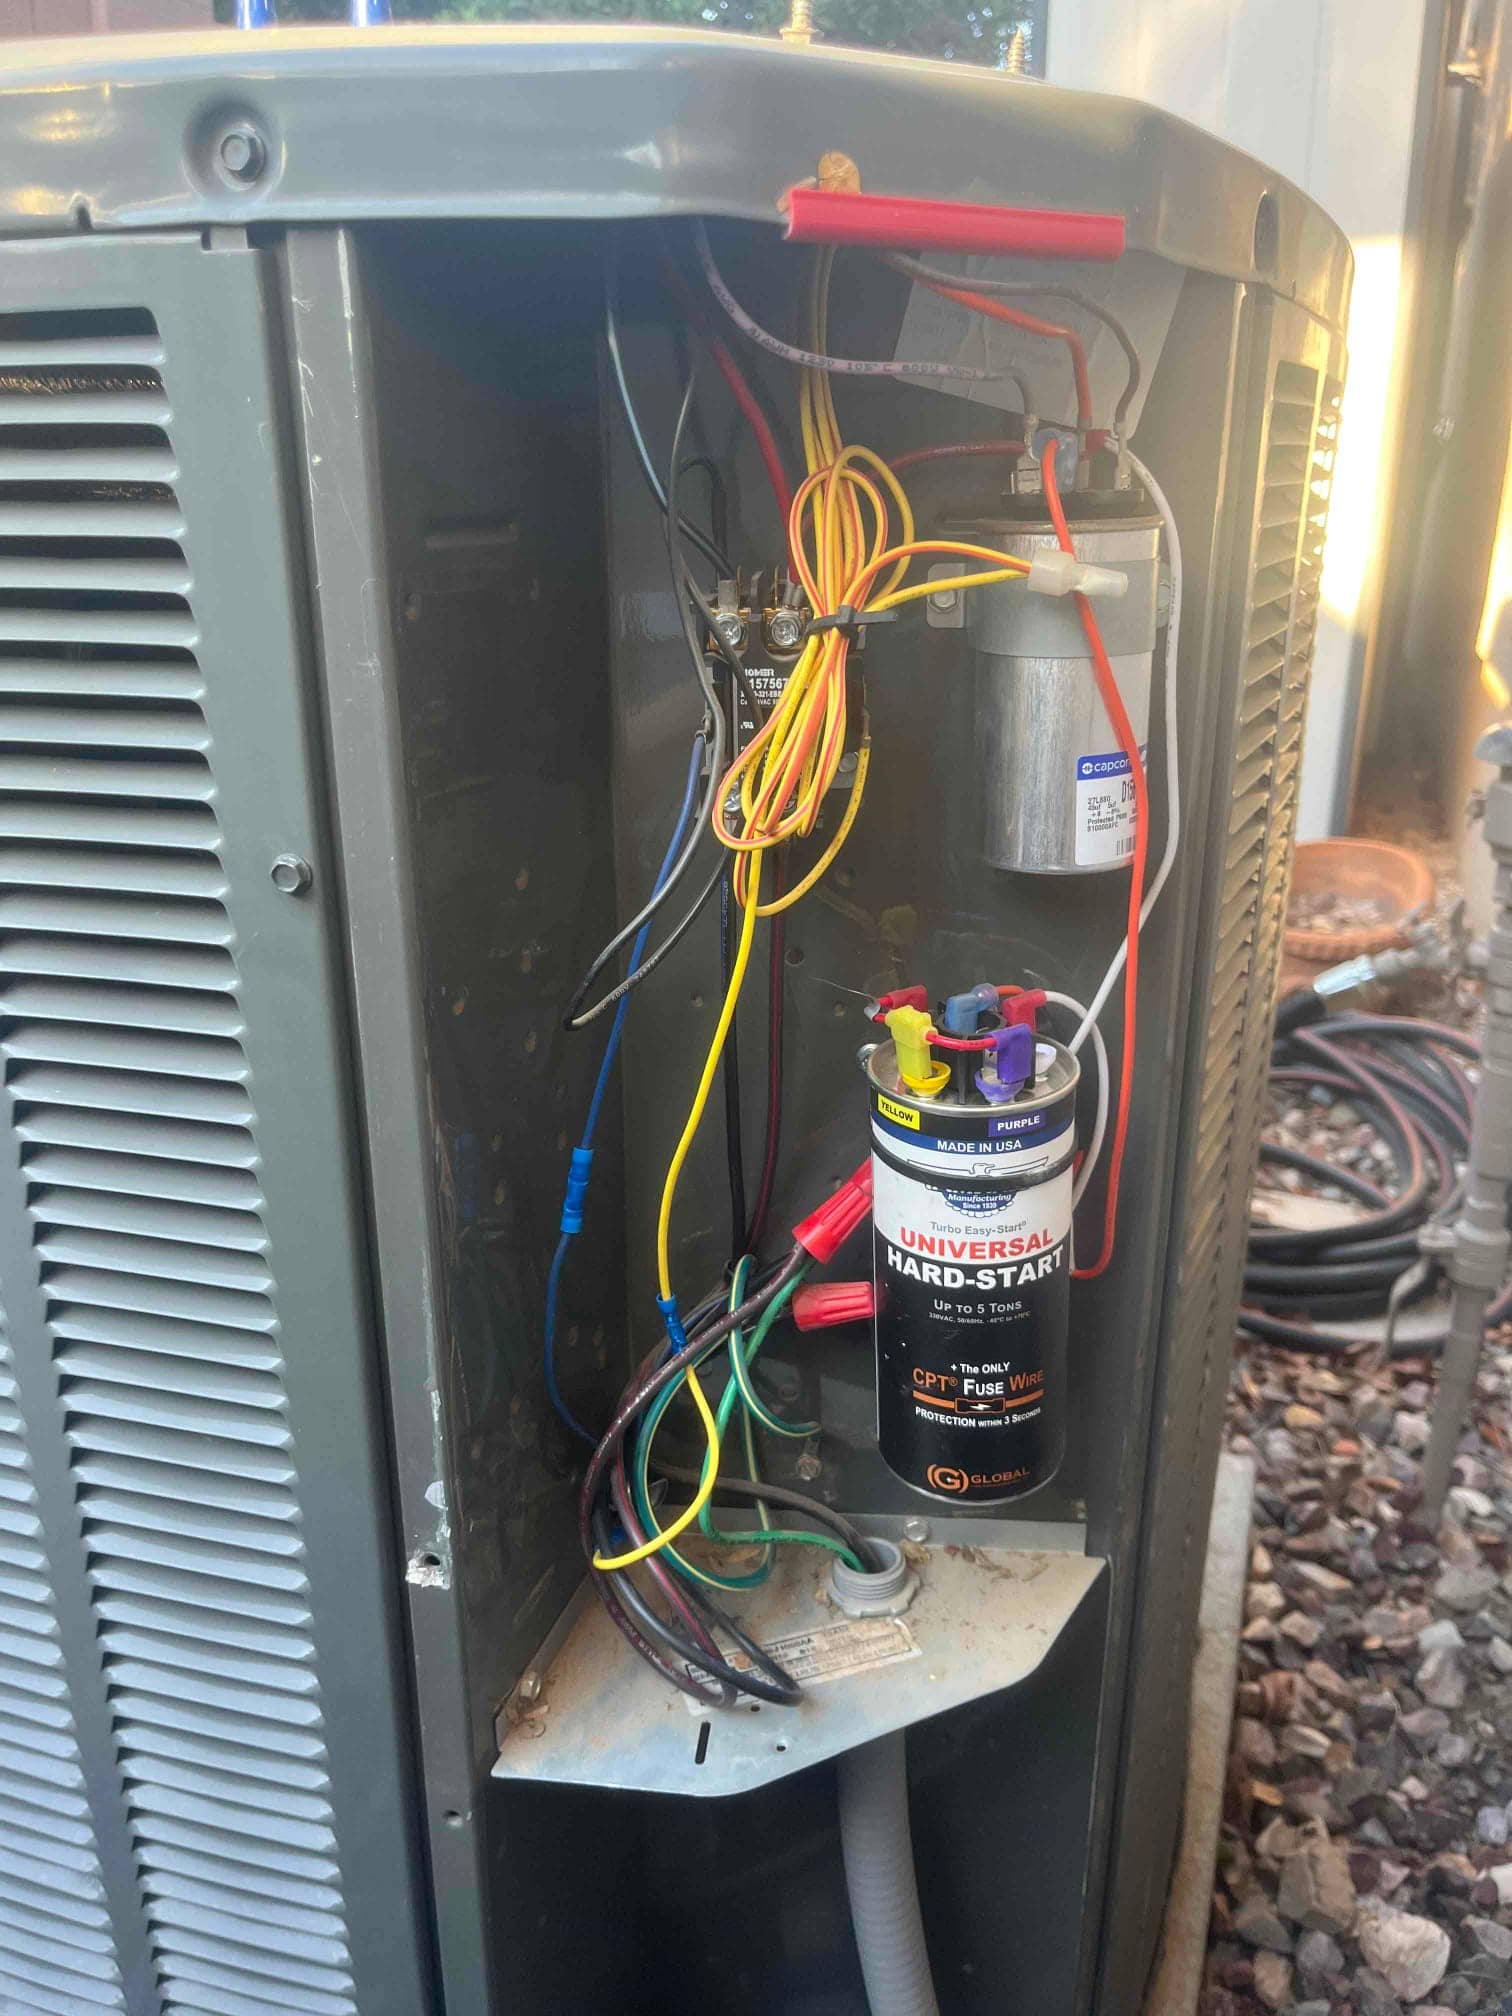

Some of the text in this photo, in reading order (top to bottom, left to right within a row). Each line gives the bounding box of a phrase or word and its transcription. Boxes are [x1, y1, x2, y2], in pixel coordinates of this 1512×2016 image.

[881, 1099, 914, 1122] YELLOW
[997, 1115, 1041, 1131] PURPLE
[937, 1139, 1022, 1152] MADE IN USA
[948, 1193, 1011, 1203] Manufacturing
[931, 1221, 962, 1235] Turbo
[900, 1226, 1054, 1260] UNIVERSAL
[887, 1243, 1064, 1291] HARD-START
[977, 1303, 985, 1314] 5
[960, 1363, 979, 1374] The
[982, 1361, 1010, 1374] ONLY
[915, 1406, 976, 1427] PROTECTION
[1004, 1416, 1010, 1425] 3
[971, 1467, 1030, 1485] GLOBAL
